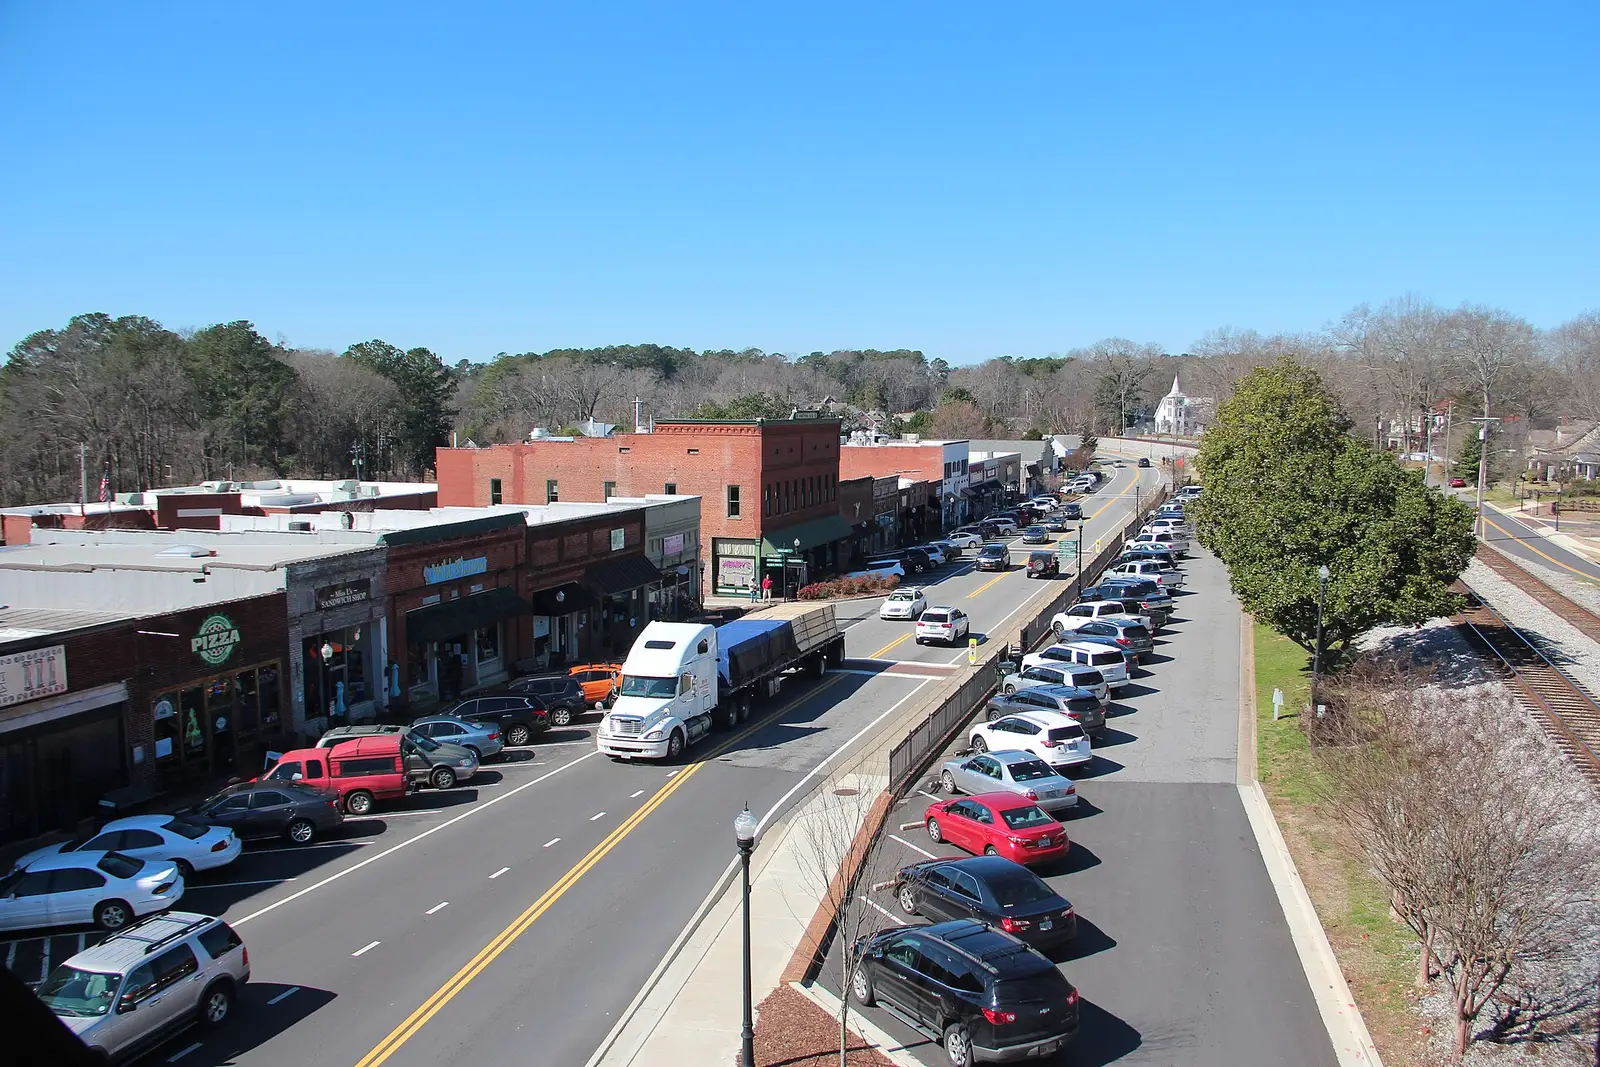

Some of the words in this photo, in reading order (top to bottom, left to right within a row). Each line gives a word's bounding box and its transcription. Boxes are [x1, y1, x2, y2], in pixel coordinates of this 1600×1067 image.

[321, 594, 352, 609] SANDWICH
[352, 591, 367, 602] SHOP
[191, 629, 241, 652] PIZZA
